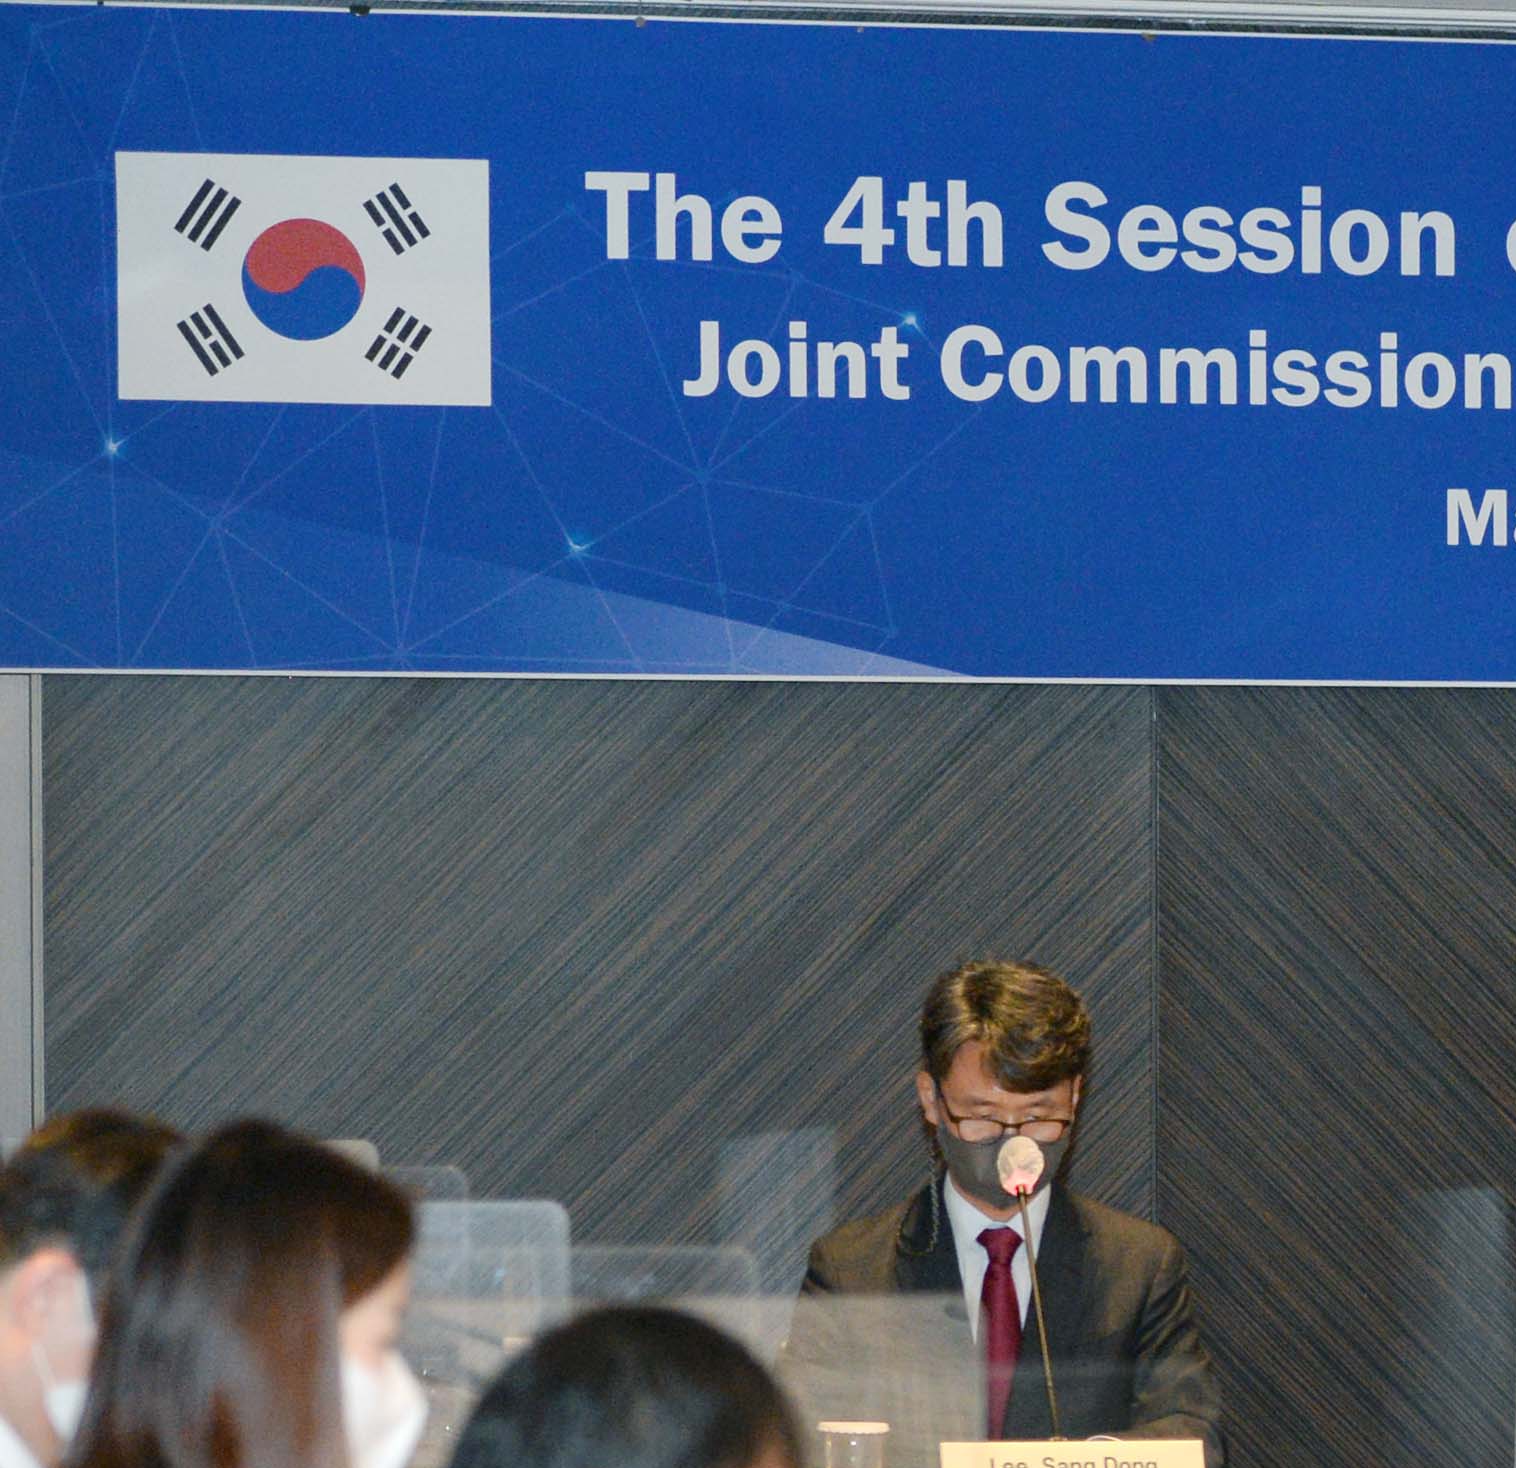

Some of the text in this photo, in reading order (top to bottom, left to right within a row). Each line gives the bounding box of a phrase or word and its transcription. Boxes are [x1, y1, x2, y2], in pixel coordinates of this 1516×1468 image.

[585, 172, 782, 263] The
[822, 174, 1003, 268] 4th
[1042, 181, 1455, 276] Session
[683, 320, 912, 400] Joint
[941, 325, 1511, 409] Commission
